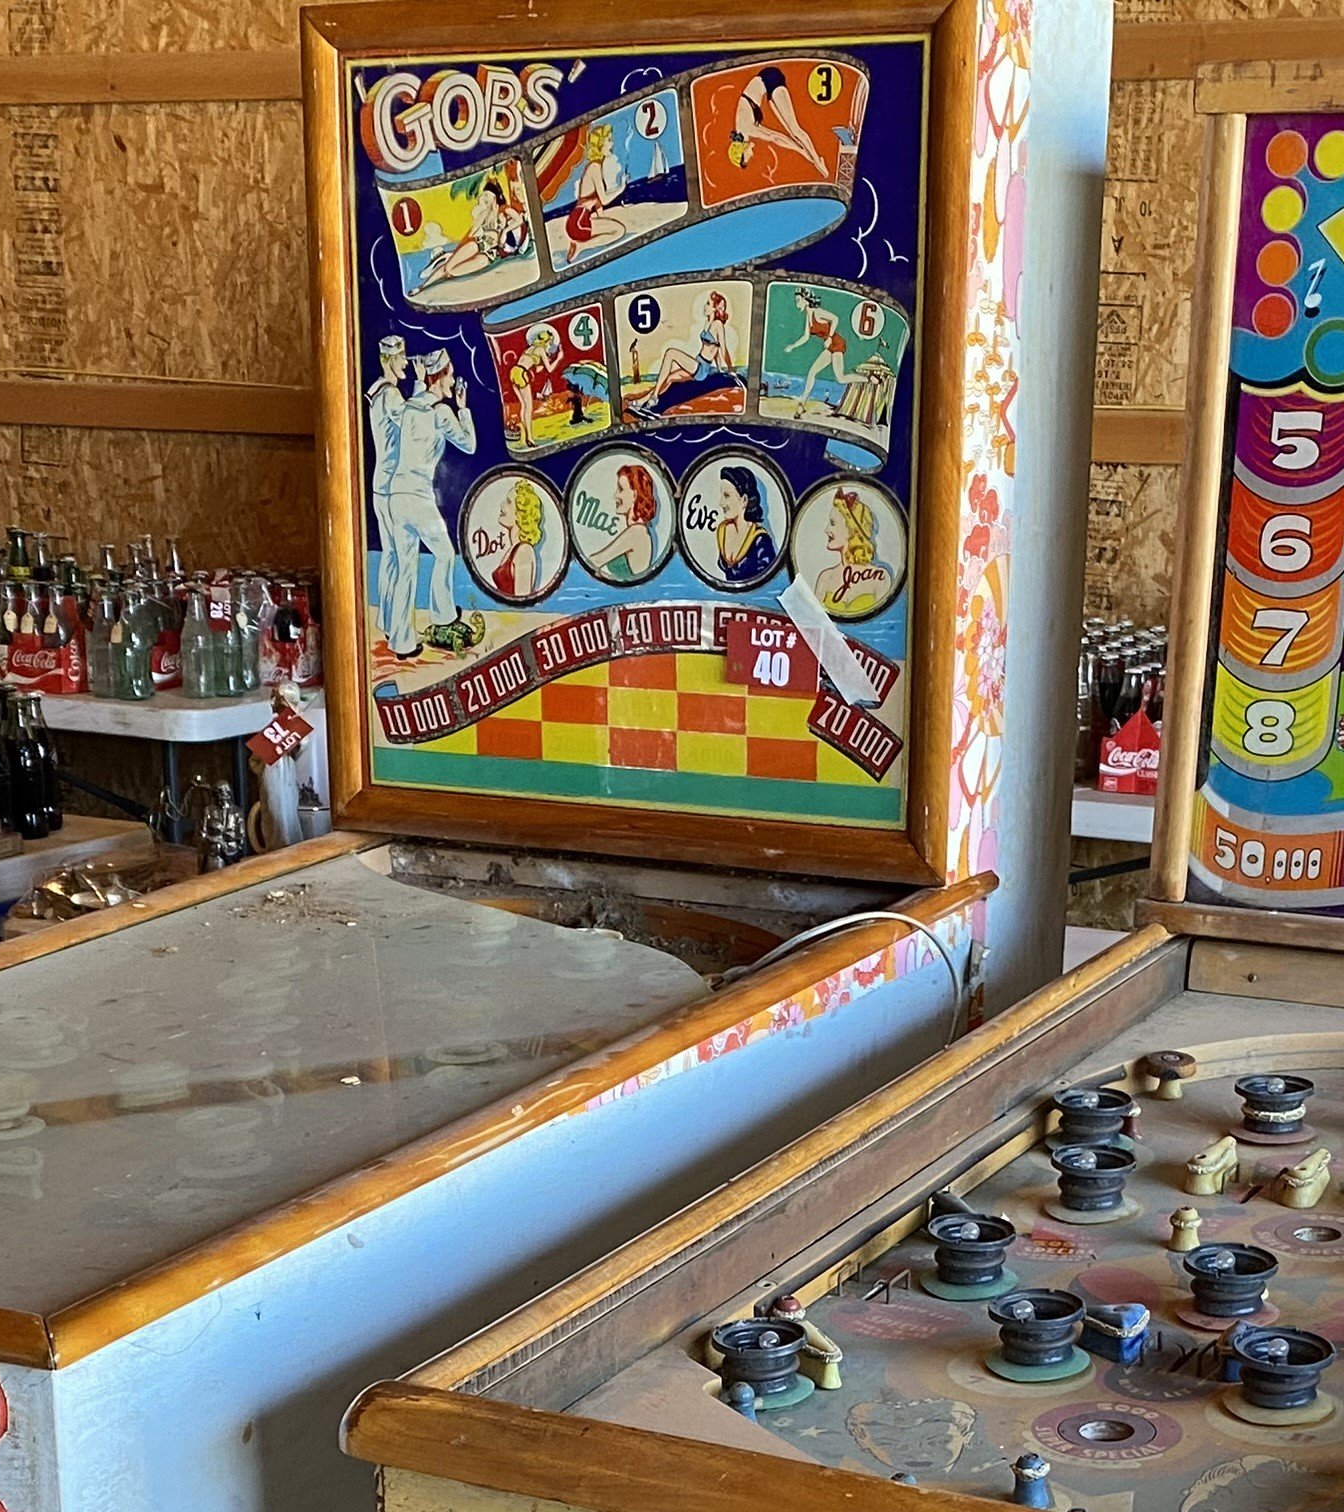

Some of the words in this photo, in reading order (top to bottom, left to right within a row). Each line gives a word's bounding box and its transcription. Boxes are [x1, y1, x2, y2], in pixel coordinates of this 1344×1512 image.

[816, 66, 834, 102] 3
[641, 101, 659, 136] 2
[400, 204, 415, 230] 1
[572, 313, 594, 348] 4
[636, 302, 653, 332] 5
[858, 303, 876, 336] 6
[1269, 409, 1327, 470] 5
[574, 491, 620, 538] Mae
[685, 493, 719, 533] Eve
[472, 524, 507, 560] Dot
[1259, 512, 1314, 574] 6
[835, 564, 887, 600] Joan
[625, 611, 658, 644] 40
[657, 609, 703, 643] 000
[750, 628, 785, 648] LOT
[785, 633, 798, 649] #
[1252, 607, 1310, 670] 7
[11, 649, 58, 669] Coca-Cola
[752, 650, 791, 687] 40
[262, 719, 290, 744] 73
[1242, 700, 1299, 758] 8
[1213, 823, 1324, 883] 50,000
[1079, 1442, 1167, 1461] SPECIAL
